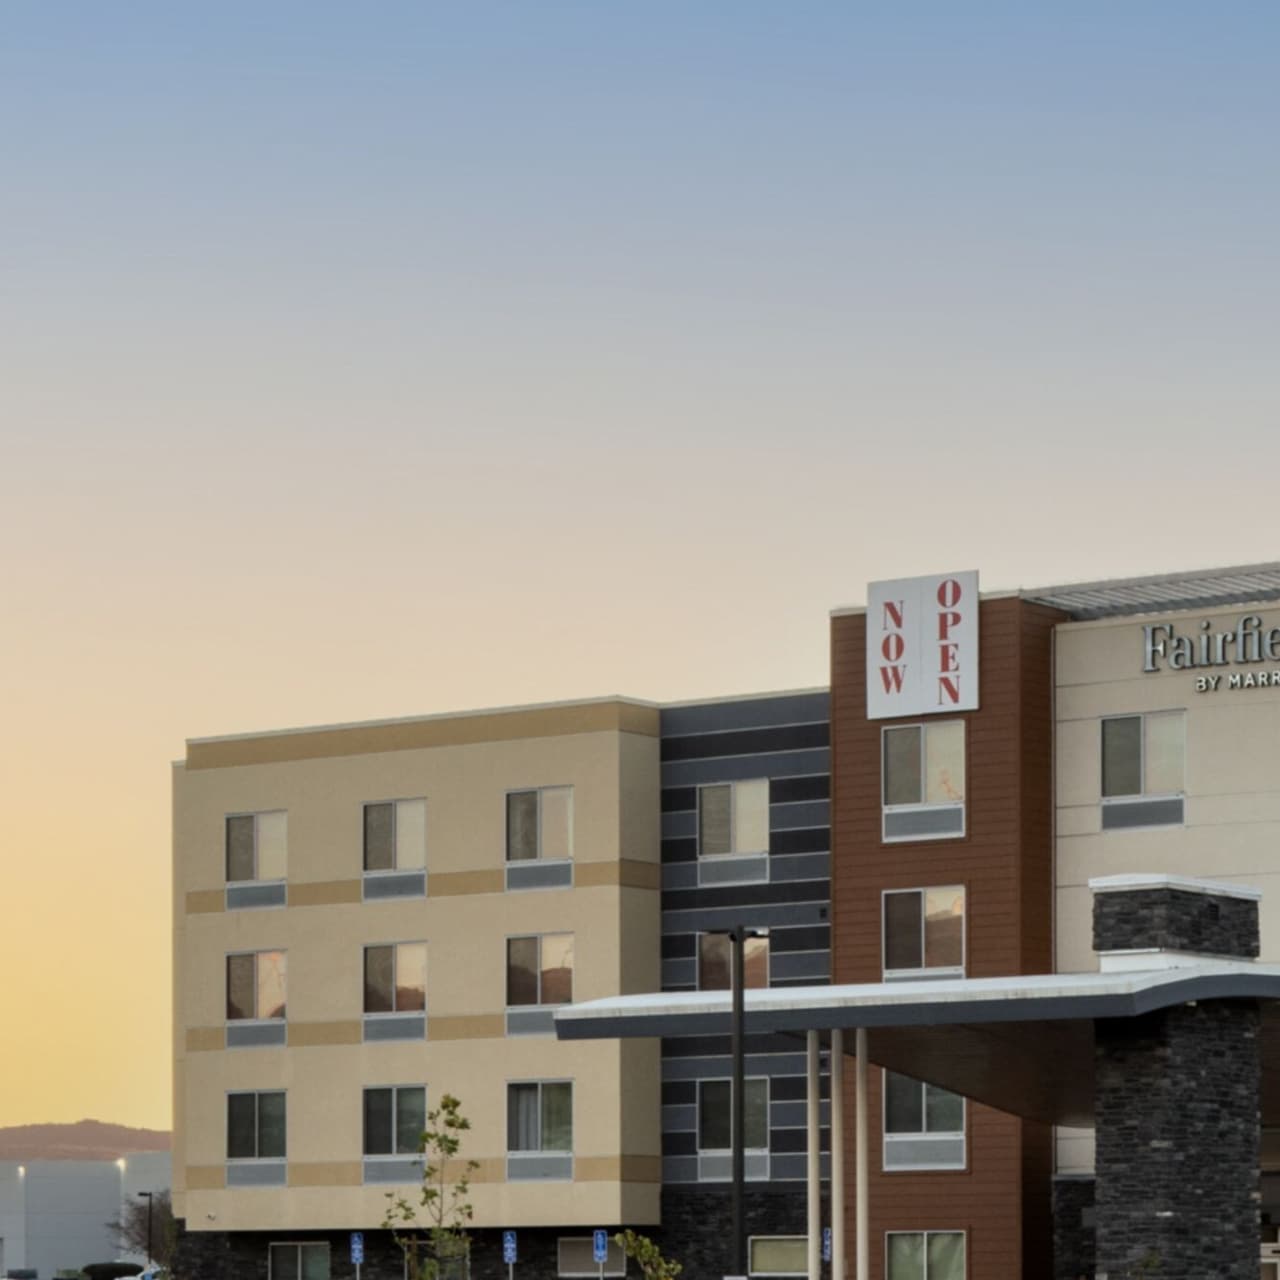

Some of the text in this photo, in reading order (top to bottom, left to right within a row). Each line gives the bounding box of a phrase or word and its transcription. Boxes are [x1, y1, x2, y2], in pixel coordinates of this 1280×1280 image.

[880, 600, 907, 695] NOW
[937, 579, 962, 705] OPEN
[1195, 676, 1221, 693] BY
